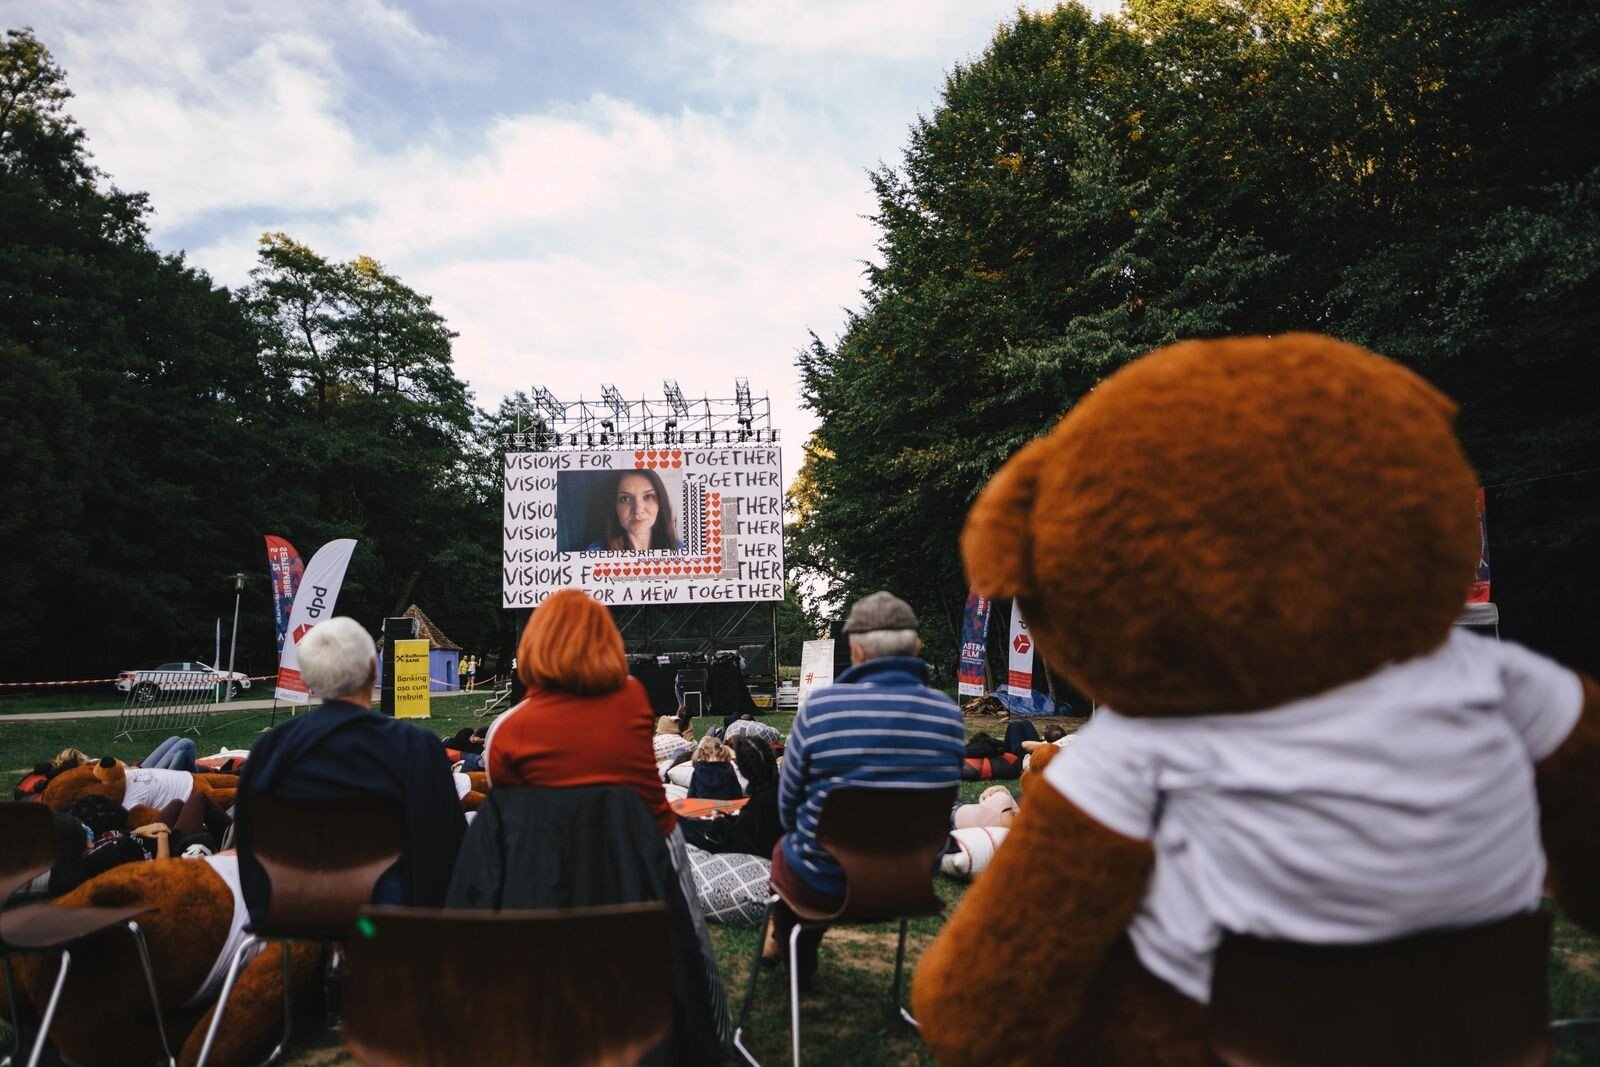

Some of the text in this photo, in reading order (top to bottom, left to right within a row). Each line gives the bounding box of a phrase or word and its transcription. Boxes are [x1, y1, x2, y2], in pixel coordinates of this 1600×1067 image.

[579, 454, 613, 469] FOR
[684, 450, 777, 466] TOGETHER
[737, 496, 779, 515] THER
[737, 520, 780, 535] THER
[738, 560, 782, 580] THER
[622, 587, 633, 601] A
[641, 586, 678, 602] NEW
[688, 583, 783, 600] TOGETHER
[961, 650, 980, 659] FILM
[963, 642, 986, 652] ASTRA
